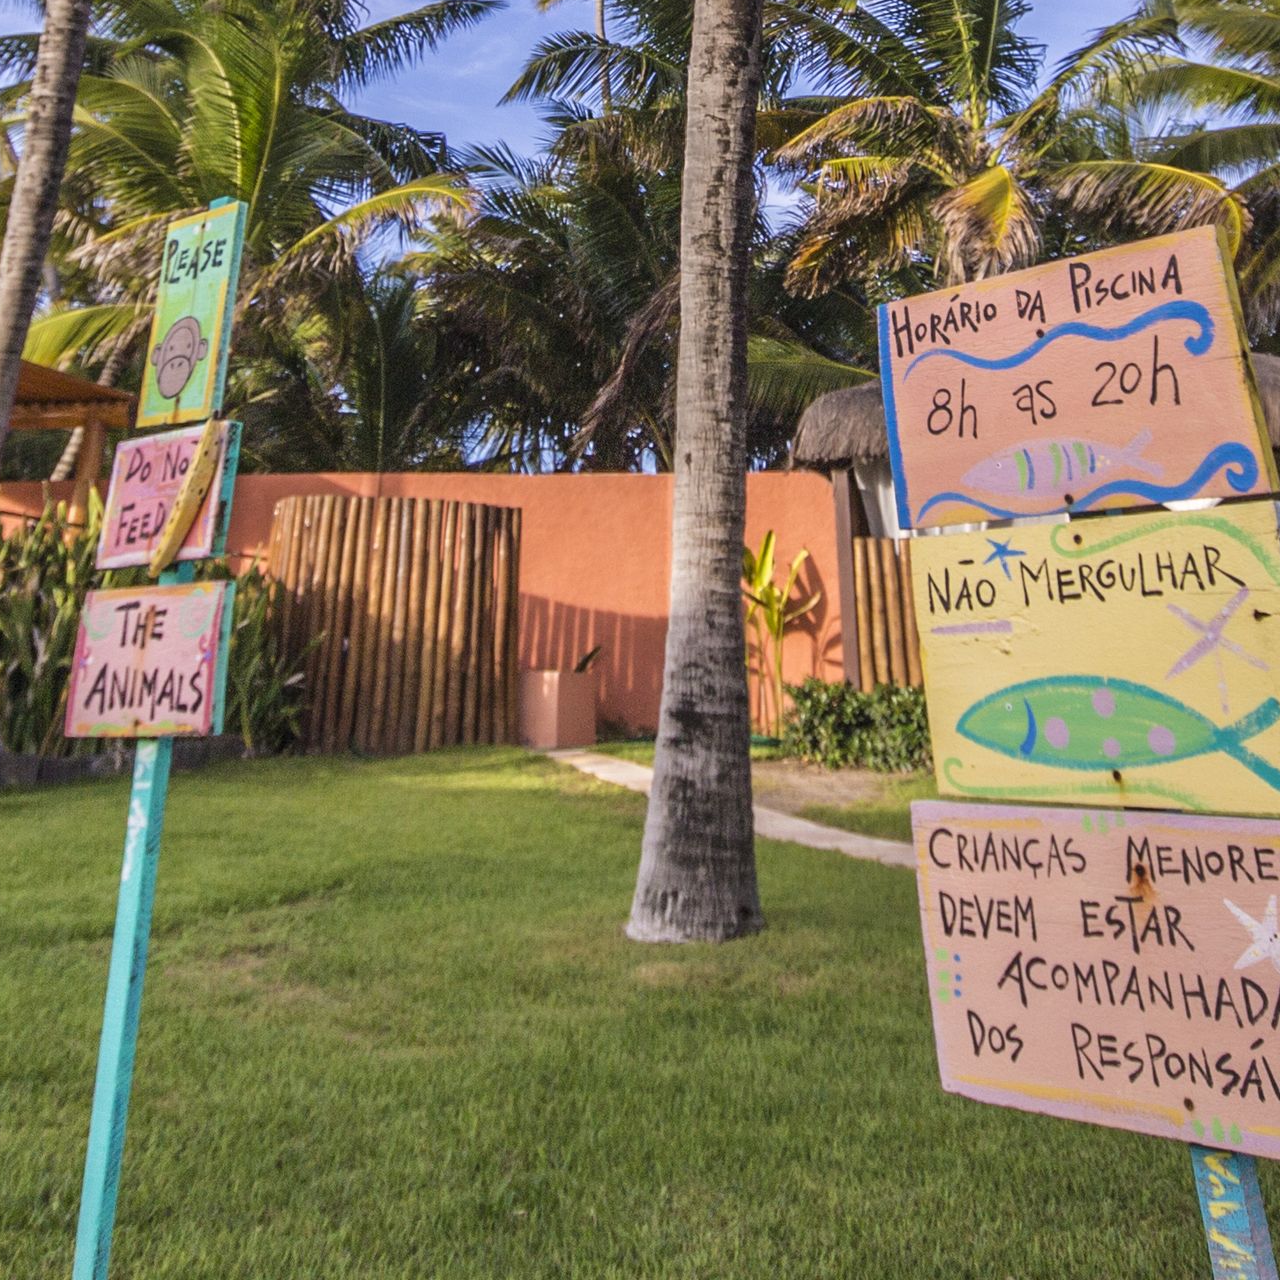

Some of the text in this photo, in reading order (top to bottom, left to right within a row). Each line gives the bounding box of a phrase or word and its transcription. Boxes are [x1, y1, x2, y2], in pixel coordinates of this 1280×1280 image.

[163, 238, 227, 284] PLEASE
[892, 254, 1183, 357] HORÁRIO DA PISCINA
[926, 378, 978, 438] 8h
[1091, 335, 1180, 407] 20h
[162, 440, 199, 482] NO
[115, 502, 166, 547] FEED
[928, 545, 1246, 614] NÃO MERGULHAR
[115, 601, 167, 650] THE
[84, 663, 203, 721] ANIMALS
[928, 828, 1087, 879] CRIANÇAS
[938, 890, 1196, 955] DEVEM ESTAR
[967, 1009, 1024, 1063] DOS
